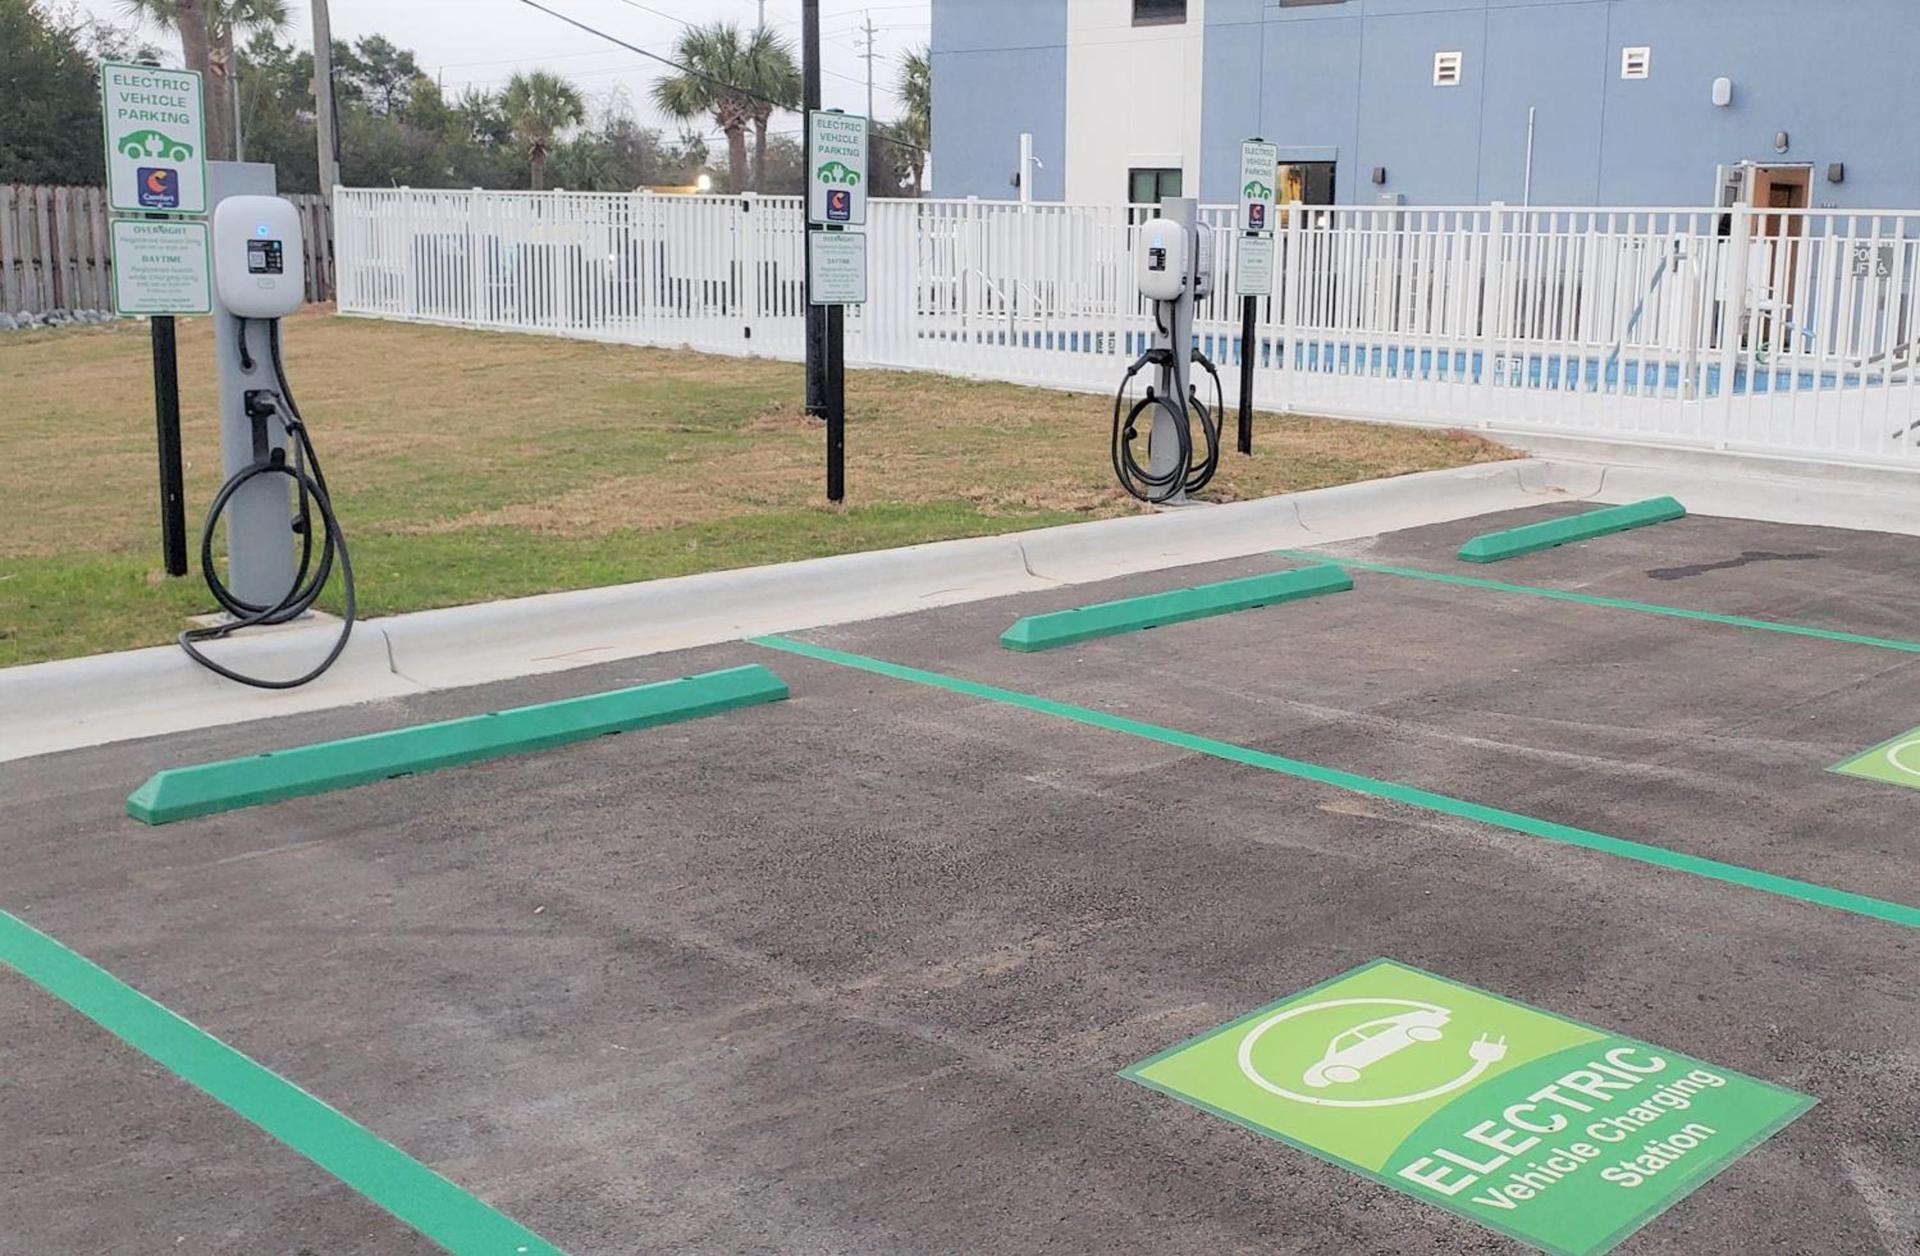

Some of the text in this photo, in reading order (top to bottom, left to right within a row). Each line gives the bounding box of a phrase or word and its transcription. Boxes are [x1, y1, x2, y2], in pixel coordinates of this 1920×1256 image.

[113, 74, 191, 92] ELECTRIC
[119, 91, 187, 108] VEHICLE
[118, 108, 190, 125] PARKING
[817, 118, 862, 132] ELECTRIC
[820, 132, 859, 144] VEHICLE
[818, 145, 860, 157] PARKING
[142, 192, 175, 202] Comfort
[133, 226, 187, 235] OVERNIGHT
[141, 255, 182, 264] DAYTIME
[1397, 1047, 1667, 1196] ELECTRIC
[1472, 1069, 1726, 1211] Vehicle Charging
[1600, 1123, 1717, 1188] Station
